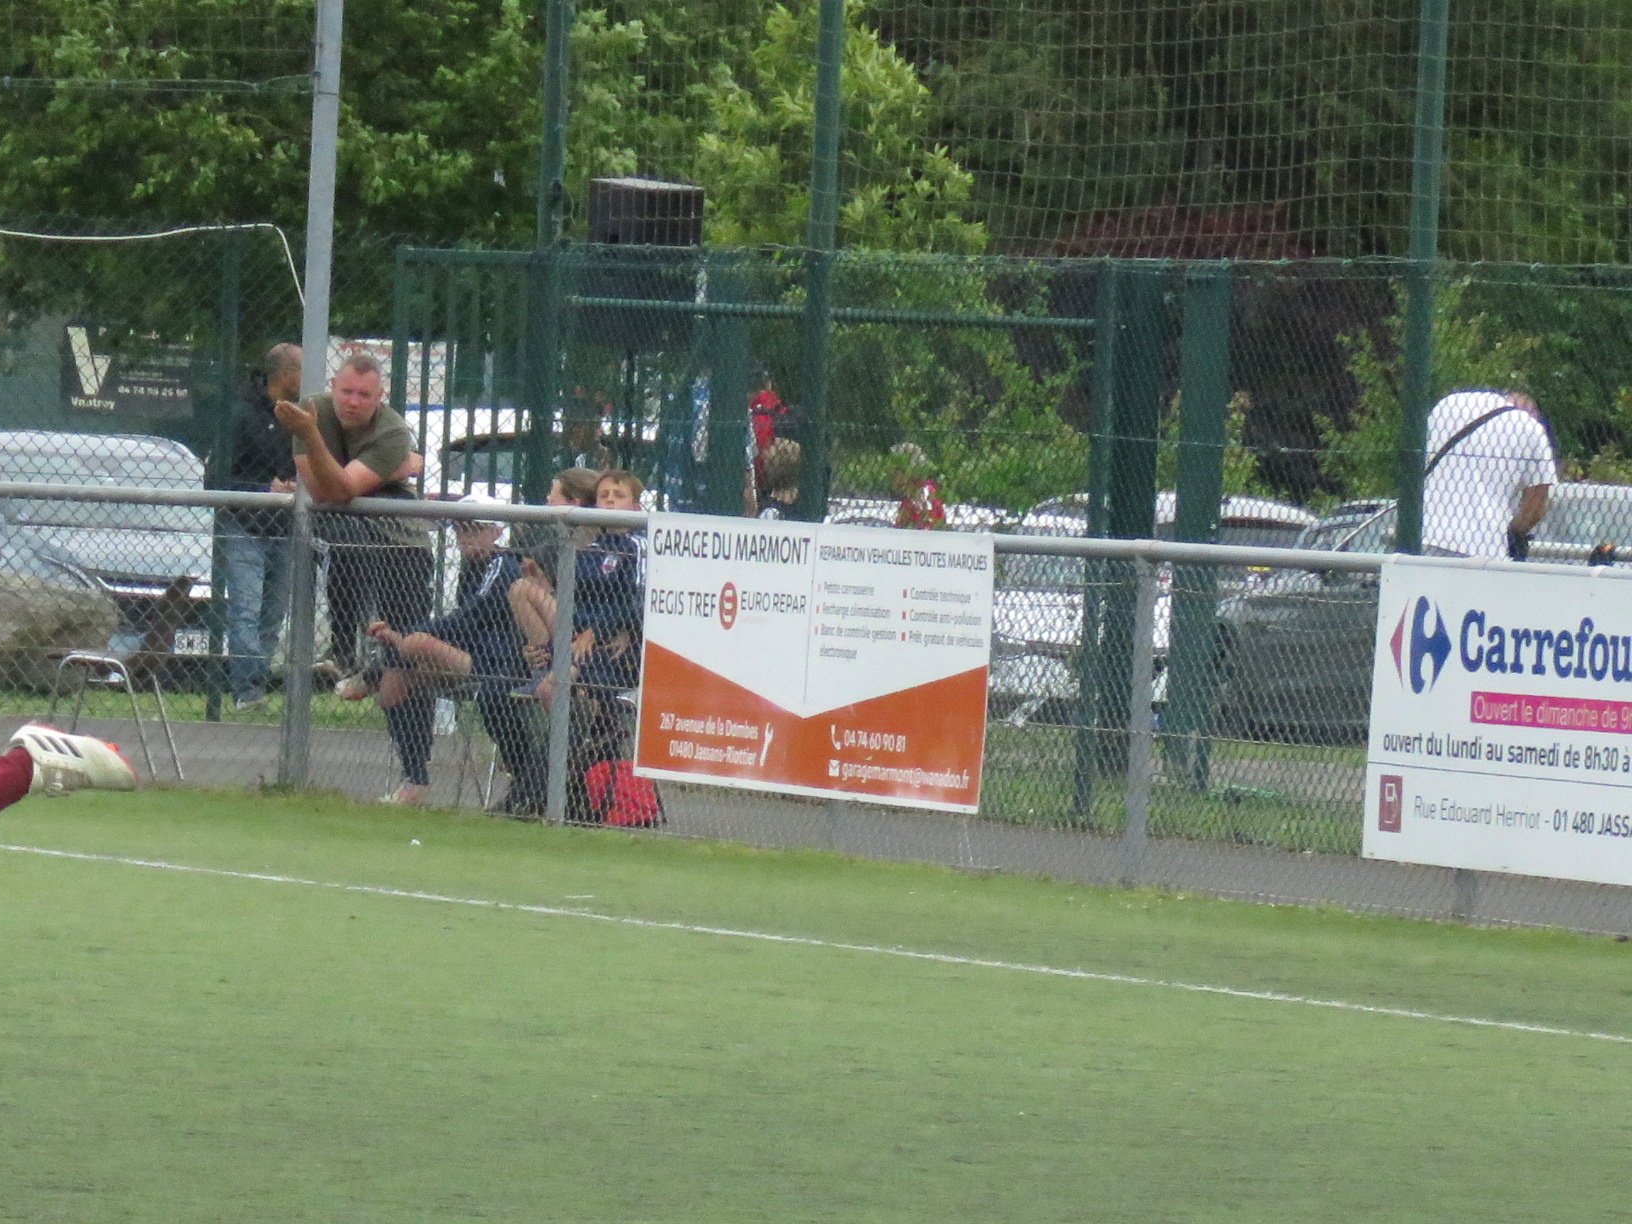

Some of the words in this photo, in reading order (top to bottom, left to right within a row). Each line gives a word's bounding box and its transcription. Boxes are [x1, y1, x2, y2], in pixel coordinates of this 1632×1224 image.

[653, 528, 709, 559] GARAGE
[712, 532, 732, 560] DU
[735, 534, 811, 565] MARMONT
[819, 545, 865, 563] REPARATION
[868, 548, 912, 566] VEHICULES
[914, 550, 947, 569] TOUTES
[948, 554, 988, 572] MARQUES
[650, 588, 684, 615] REGIS
[688, 591, 717, 618] TREF
[740, 591, 769, 611] EURO
[773, 593, 807, 614] REPAR
[1473, 695, 1519, 722] Ouvert
[1522, 699, 1534, 723] le
[1536, 700, 1598, 727] dimanche
[1601, 705, 1618, 729] de
[675, 717, 705, 734] avenue
[705, 715, 716, 735] de
[717, 716, 725, 736] la
[726, 719, 759, 740] Dombes
[843, 729, 856, 747] 04
[856, 730, 869, 748] 74
[869, 732, 881, 750] 60
[882, 733, 895, 752] 90
[895, 735, 907, 753] 81
[1383, 733, 1423, 753] ouvert
[1426, 732, 1442, 757] du
[1447, 733, 1482, 760] lundi
[1486, 742, 1503, 762] au
[1507, 741, 1559, 767] samedi
[1563, 744, 1580, 769] de
[1584, 745, 1618, 772] 8h30
[1621, 746, 1630, 773] à
[1414, 795, 1437, 820] Rue
[1440, 797, 1492, 825] Edouard
[1496, 802, 1541, 829] Herriot
[1553, 808, 1567, 832] 01
[1571, 810, 1595, 835] 480
